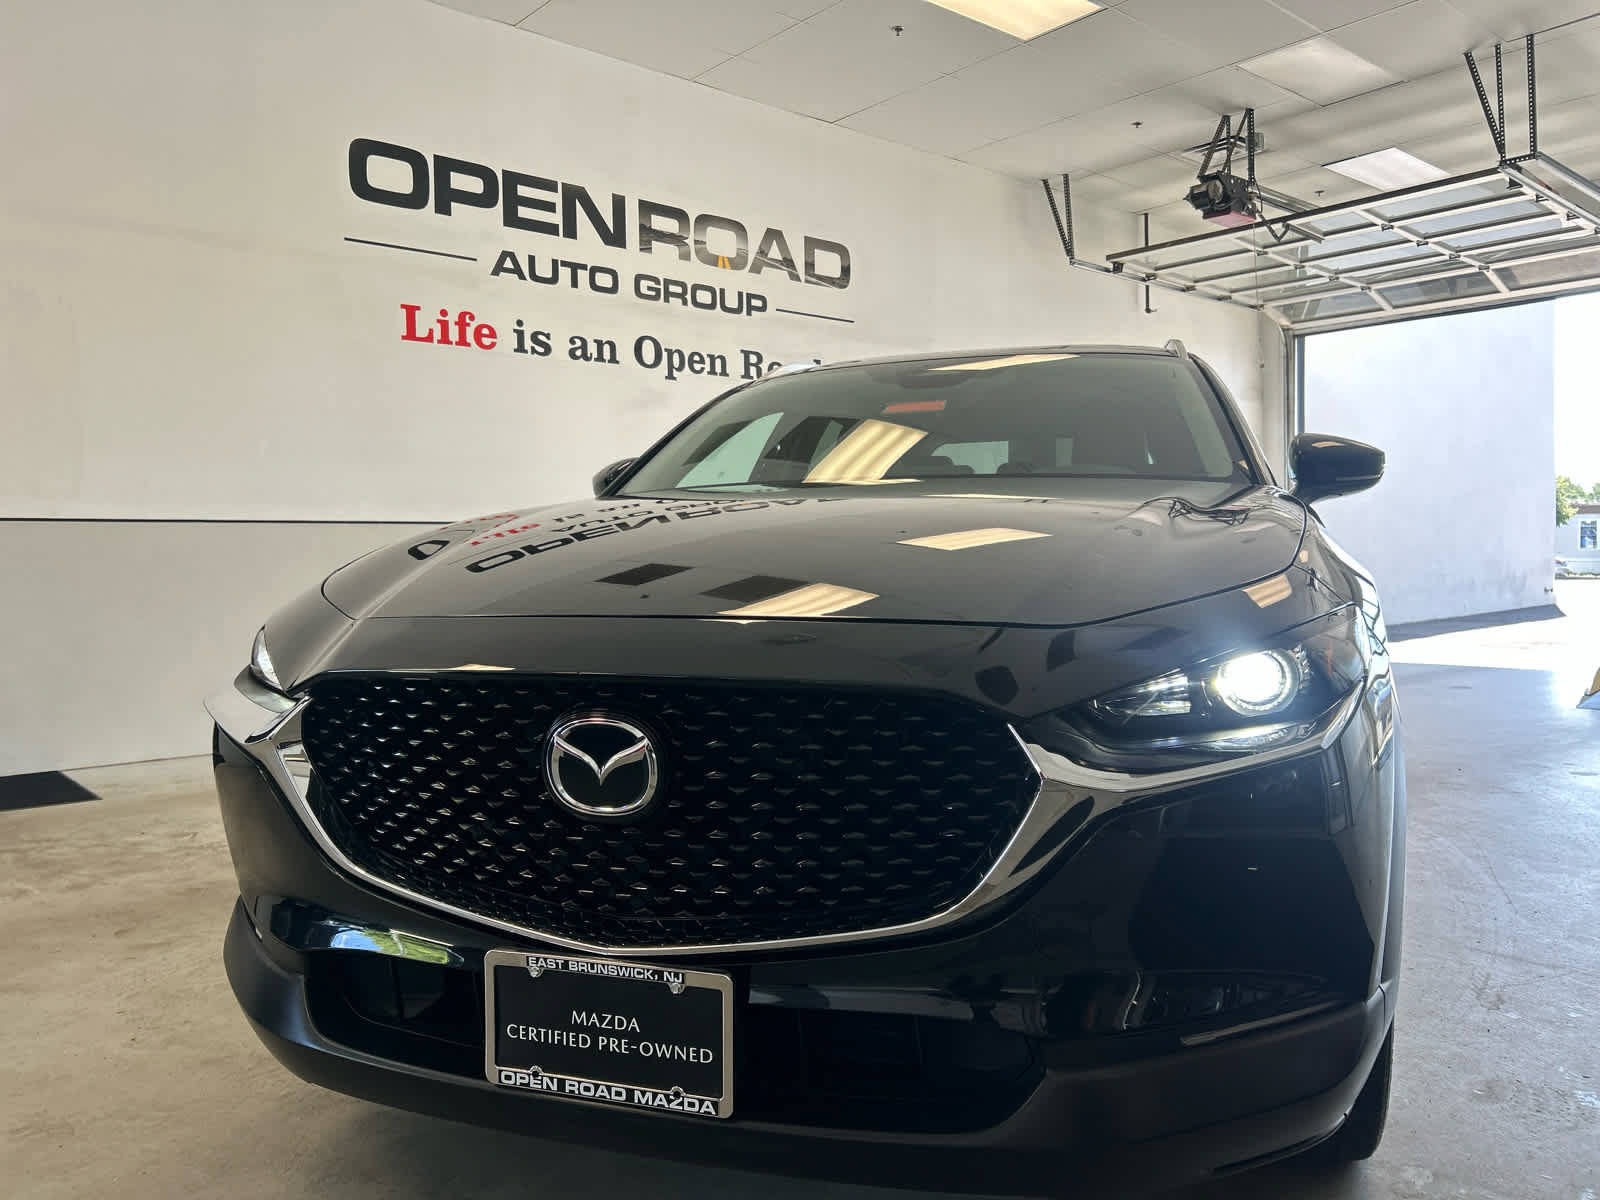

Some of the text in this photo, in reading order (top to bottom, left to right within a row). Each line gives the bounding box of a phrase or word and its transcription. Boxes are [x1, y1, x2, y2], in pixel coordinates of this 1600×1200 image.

[348, 138, 851, 290] OPEN ROAD
[490, 250, 767, 316] AUTO GROUP
[400, 304, 497, 350] Life
[513, 320, 552, 357] is
[569, 334, 619, 364] an
[633, 336, 729, 380] Open
[528, 958, 683, 983] EAST BRUNSWICK, NJ
[572, 1010, 640, 1032] MAZDA
[507, 1024, 713, 1063] CERTIFIED PRE-OWNED
[501, 1071, 716, 1114] OPEN ROAD MAZDA
